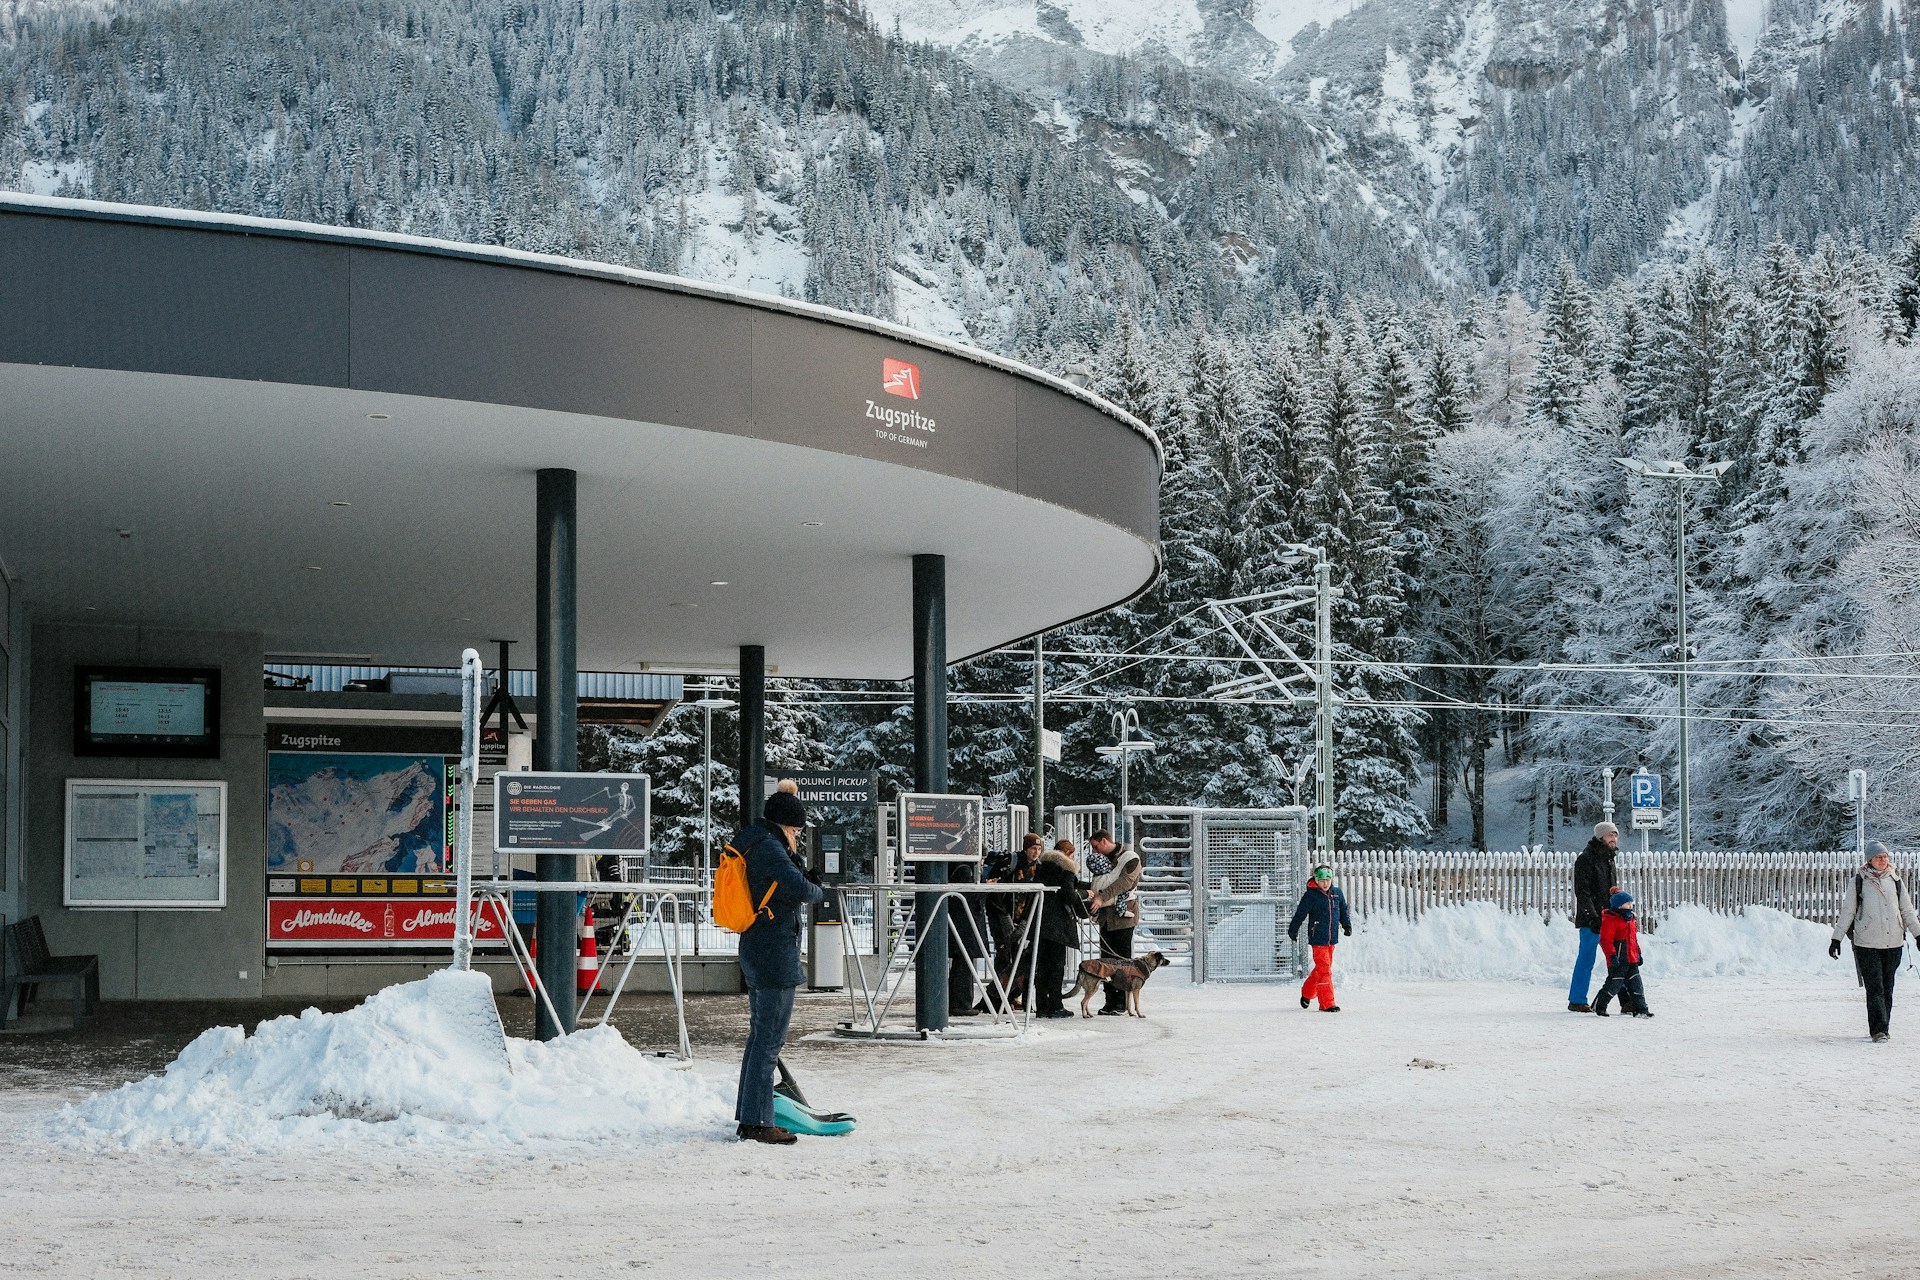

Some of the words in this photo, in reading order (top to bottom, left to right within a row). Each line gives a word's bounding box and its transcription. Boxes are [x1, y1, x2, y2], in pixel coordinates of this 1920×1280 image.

[866, 399, 936, 433] Zugspitze
[875, 430, 887, 439] TOP
[888, 433, 897, 442] OF
[898, 434, 928, 449] GERMANY
[281, 734, 341, 748] Zugspitze
[838, 778, 868, 786] PICKUP
[1637, 779, 1651, 803] P
[281, 908, 373, 932] Almdudler
